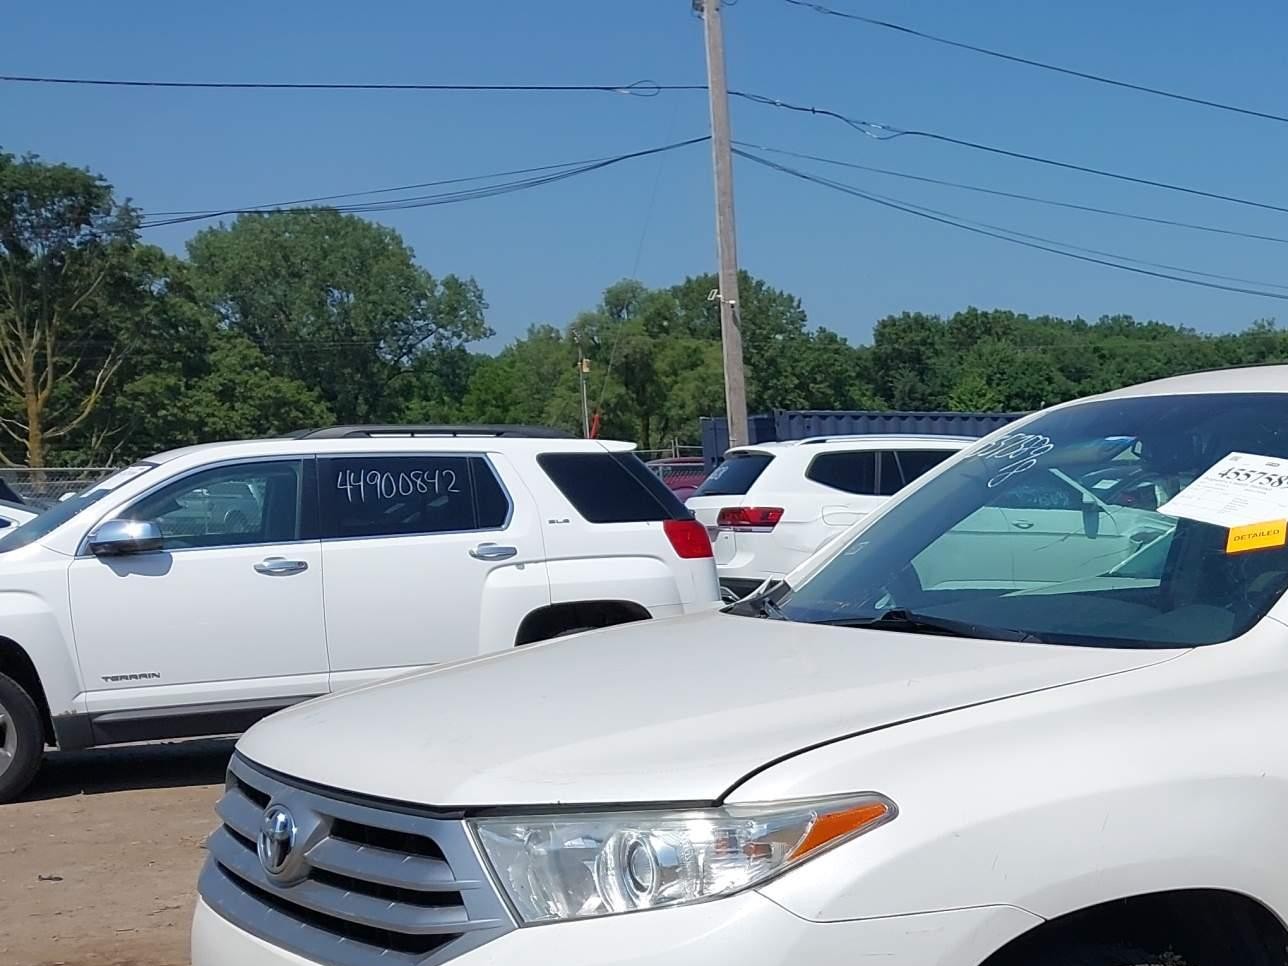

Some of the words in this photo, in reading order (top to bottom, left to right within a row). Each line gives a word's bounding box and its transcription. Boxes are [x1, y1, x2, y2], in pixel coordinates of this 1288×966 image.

[336, 469, 462, 503] 44900842
[1232, 528, 1281, 543] DETAILED
[101, 671, 161, 683] TERRAIN
